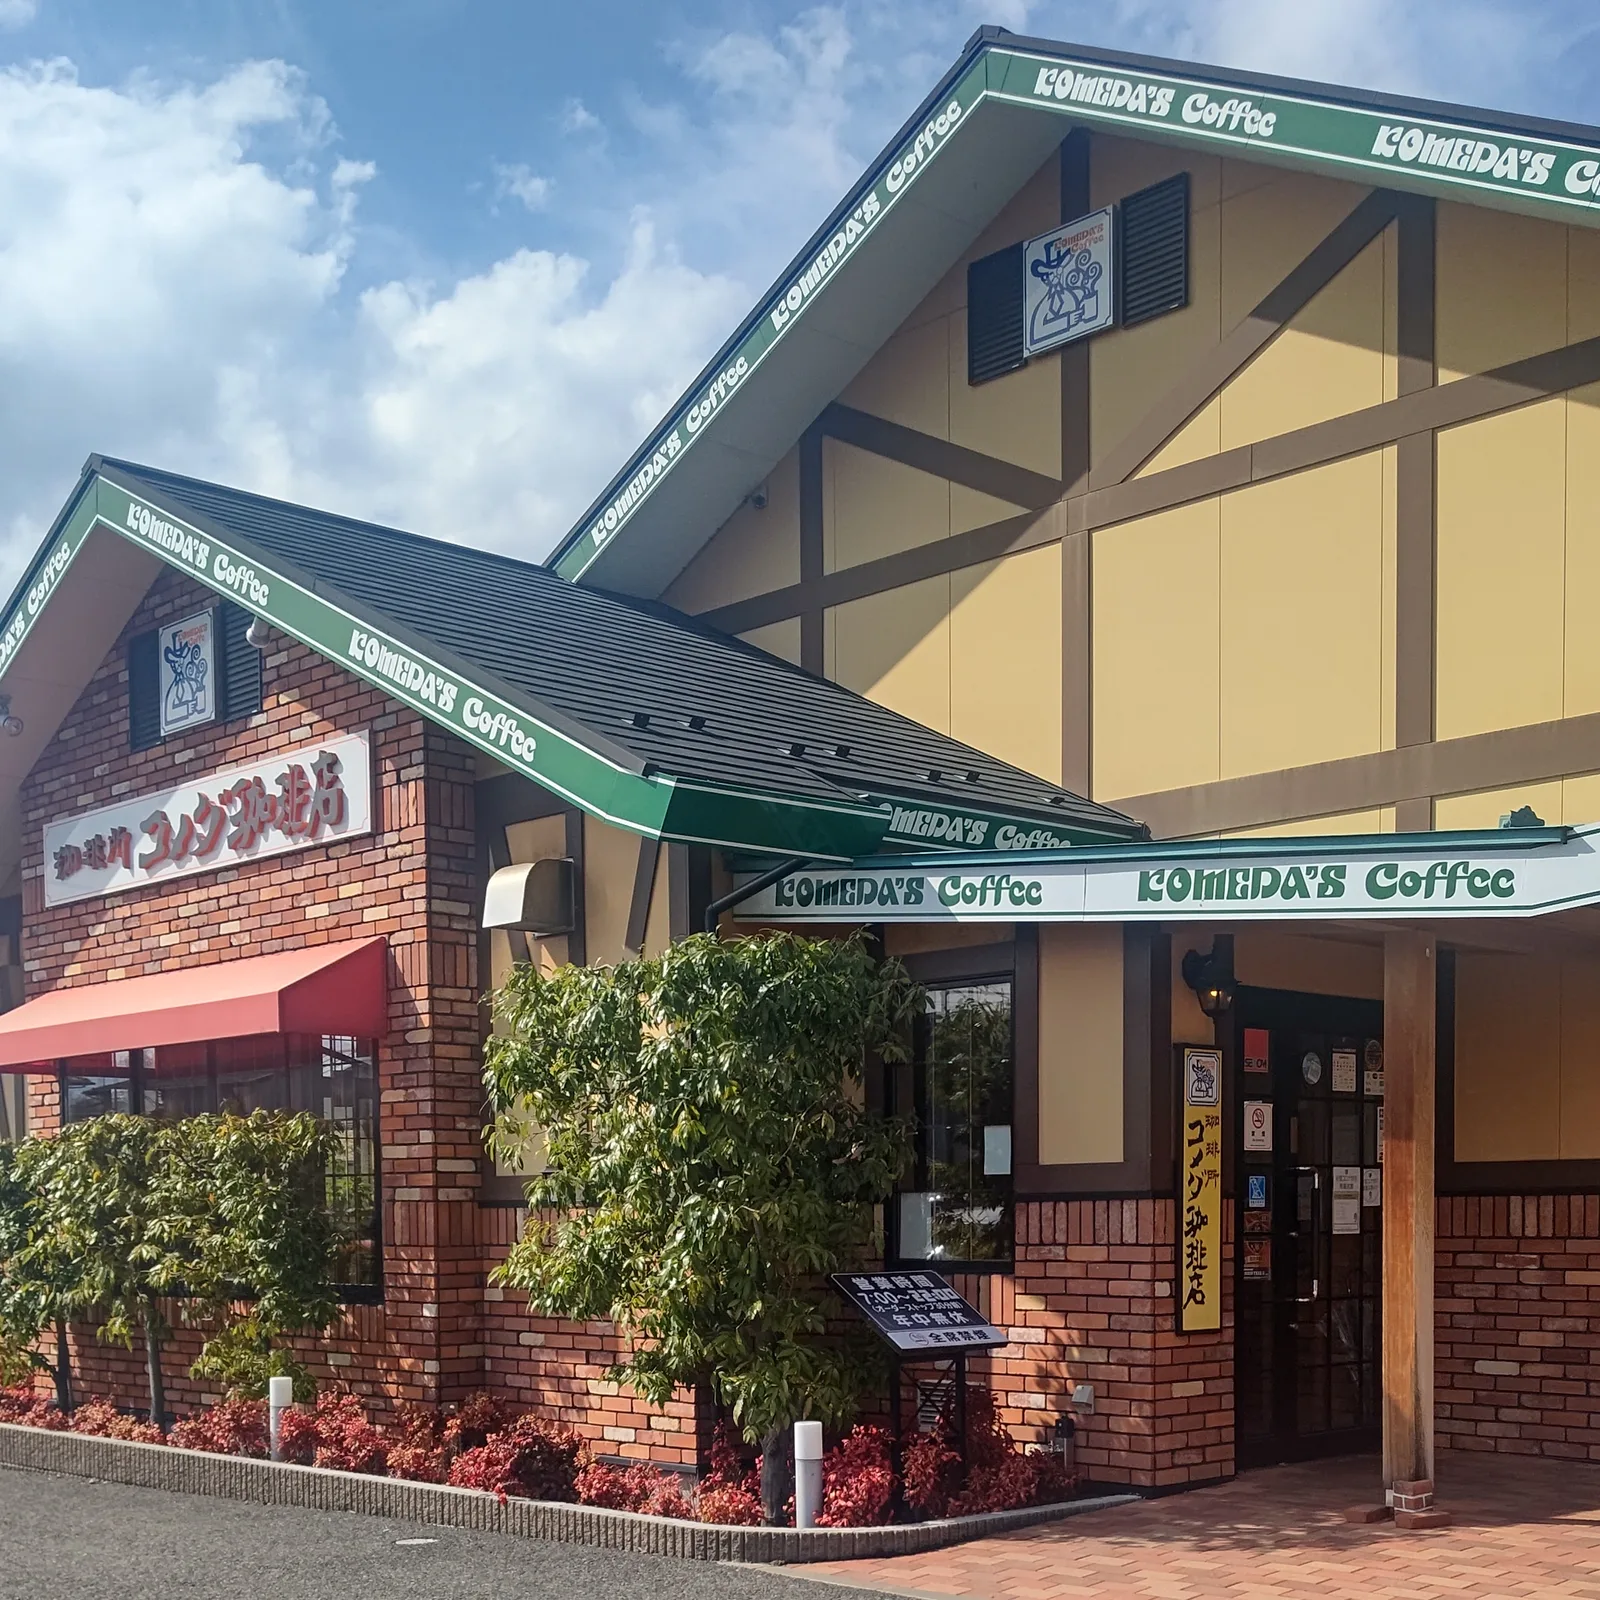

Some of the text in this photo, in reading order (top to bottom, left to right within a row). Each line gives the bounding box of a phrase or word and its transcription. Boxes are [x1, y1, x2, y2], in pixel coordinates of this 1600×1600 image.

[1034, 66, 1277, 138] KOMEDA'S Coffee
[1371, 124, 1557, 187] KOMEDA'S
[771, 99, 964, 331] KOMEDA'S Coffee
[591, 355, 749, 548] KOMEDA'S Coffee
[27, 541, 71, 615] Coffee
[126, 503, 271, 607] KOMEDA'S Coffee
[348, 628, 537, 764] KOMEDA'S Coffee
[879, 803, 989, 846] MEDA'S
[775, 874, 1043, 908] KOMEDA'S Coffee
[1138, 860, 1517, 903] KOMEDA'S Coffee
[1183, 1119, 1210, 1311] コメダ珈琲店
[851, 1274, 935, 1291] 営業時間
[892, 1311, 970, 1328] 年中無休
[928, 1329, 991, 1344] 全席禁煙
